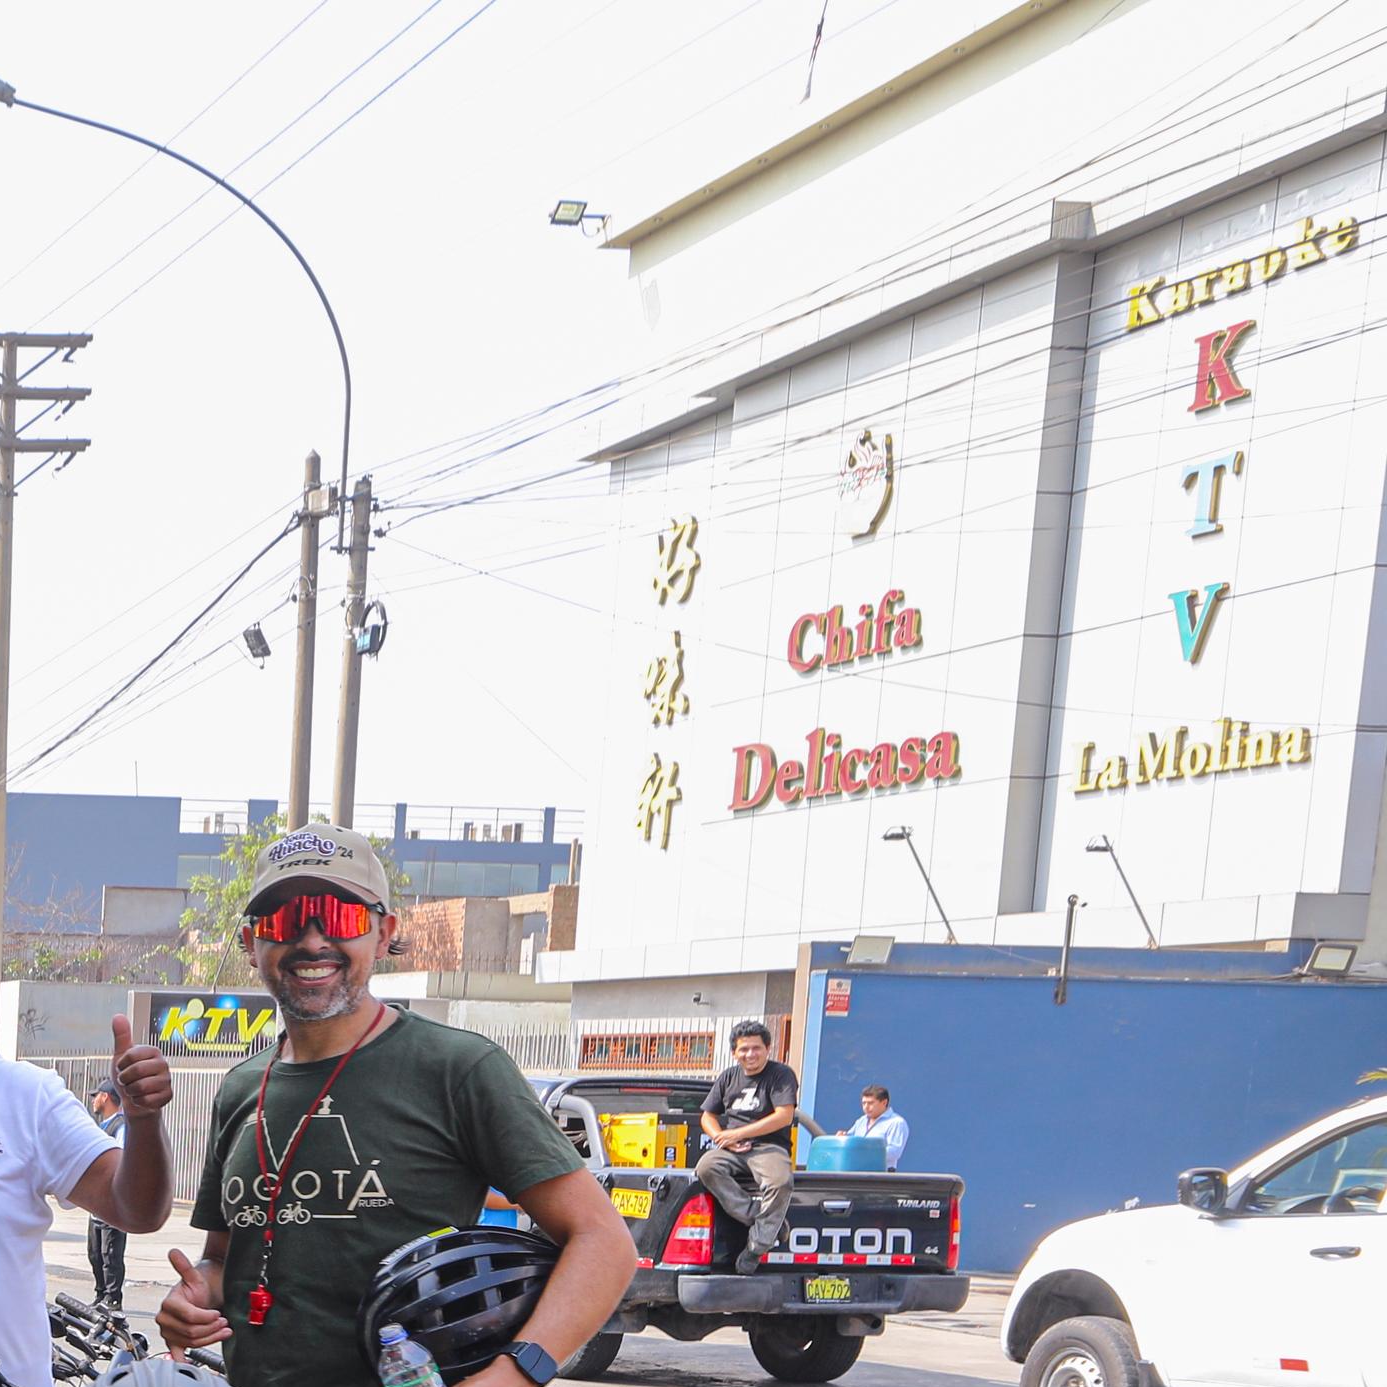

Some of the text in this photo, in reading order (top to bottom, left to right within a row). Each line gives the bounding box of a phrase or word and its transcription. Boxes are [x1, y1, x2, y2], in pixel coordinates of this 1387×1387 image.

[1126, 216, 1360, 333] Karaoke
[787, 589, 923, 674] Chifa
[728, 728, 962, 814] Delicasa
[1069, 717, 1312, 794] La Molina
[277, 859, 332, 870] TREK
[159, 1007, 274, 1043] KTV
[223, 1159, 388, 1212] OGOTÁ
[358, 1198, 395, 1208] RUEDA
[613, 1192, 649, 1214] CAY-792
[897, 1199, 940, 1208] TUNLAND
[773, 1228, 913, 1254] OTON
[807, 1283, 851, 1300] CAY-792
